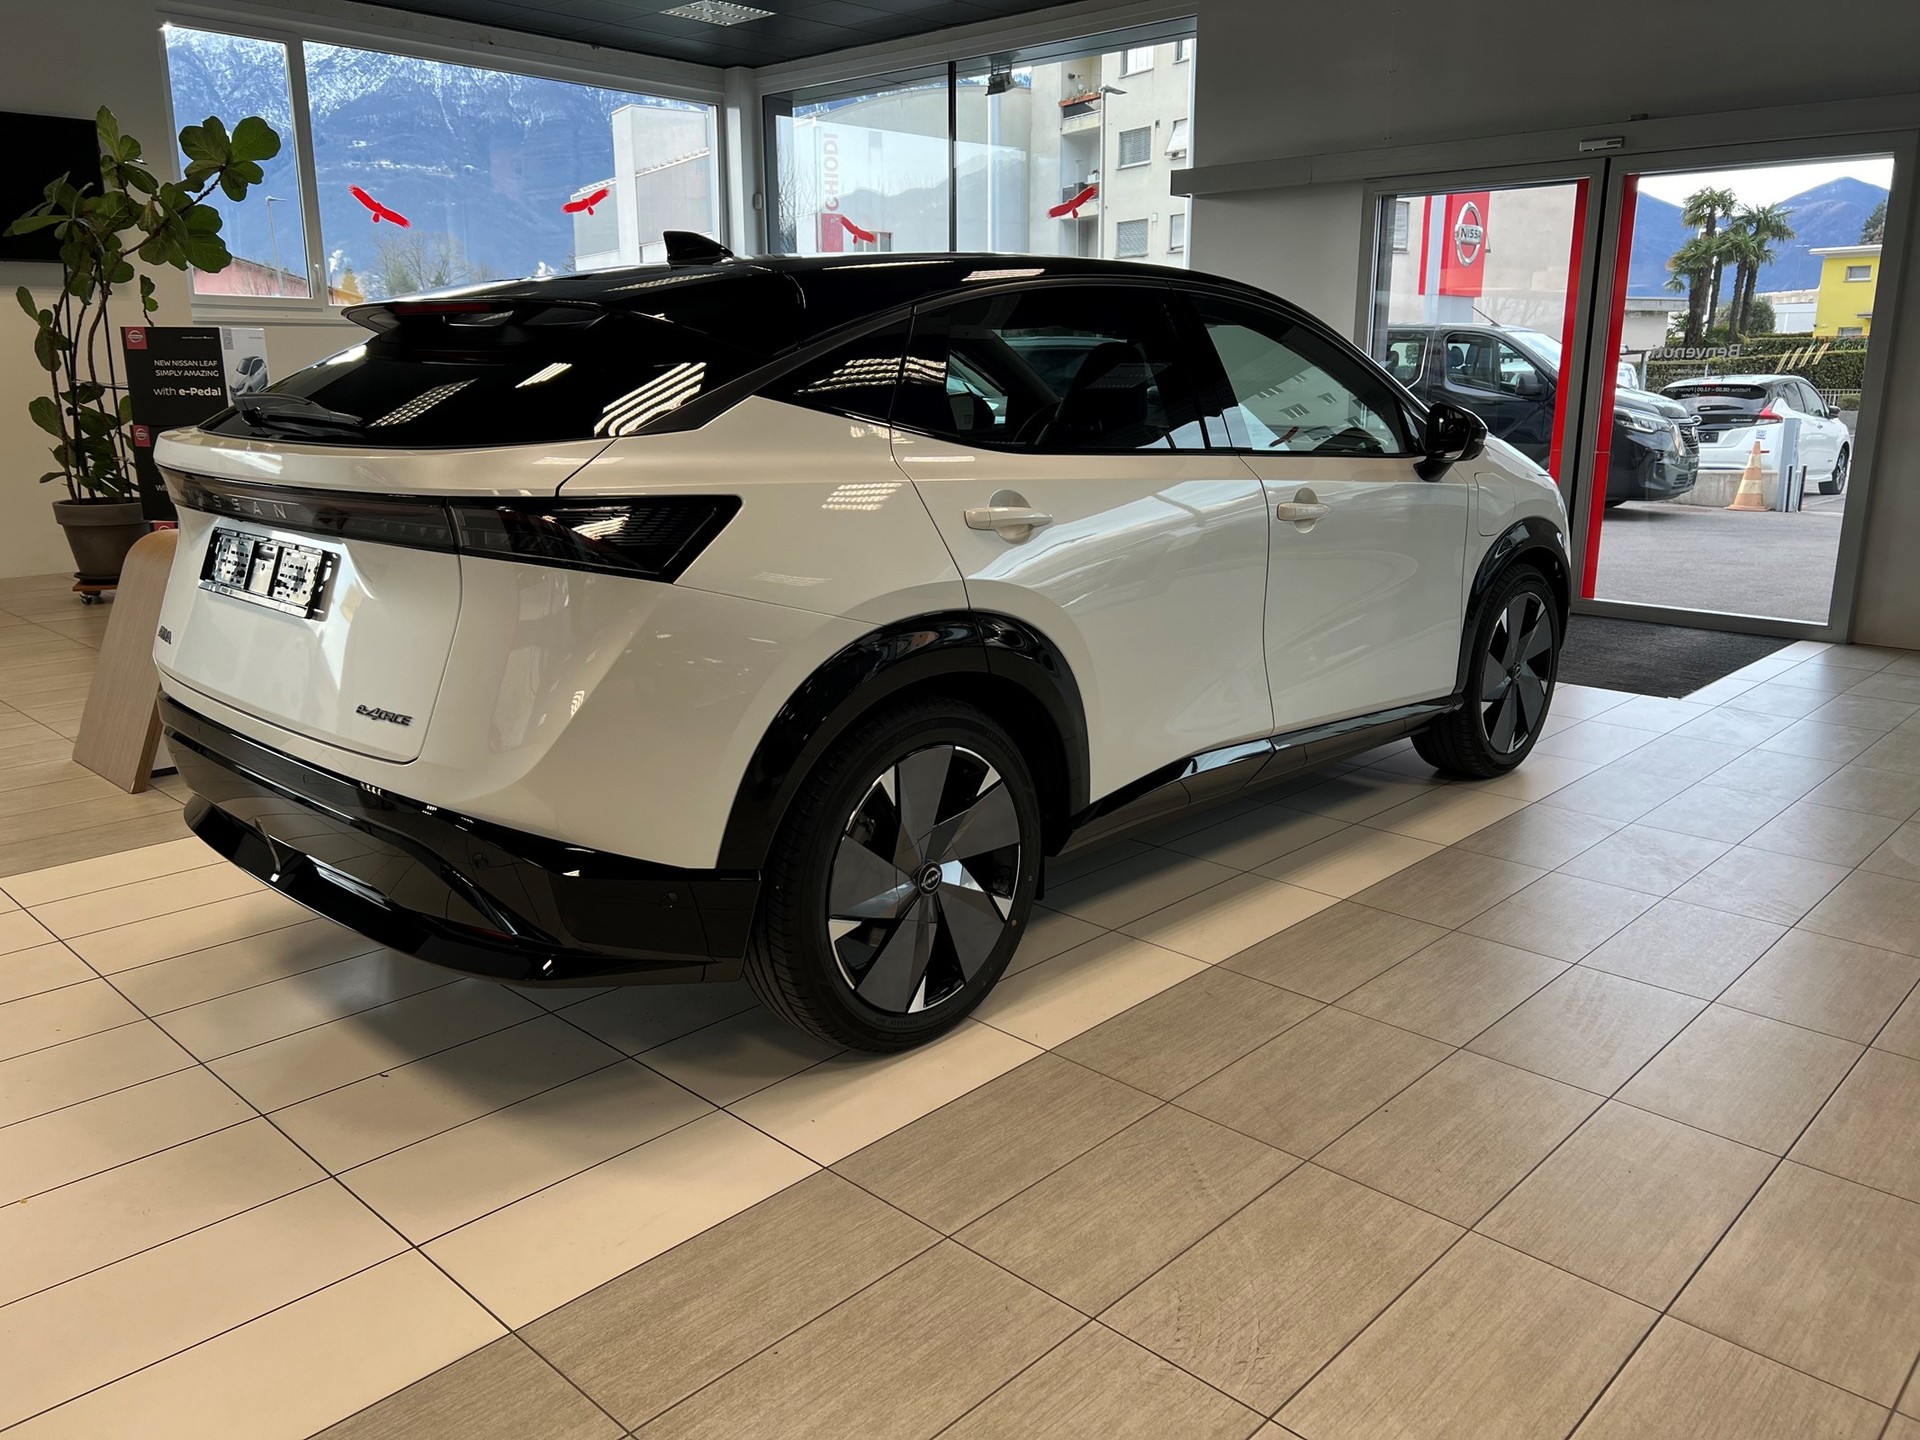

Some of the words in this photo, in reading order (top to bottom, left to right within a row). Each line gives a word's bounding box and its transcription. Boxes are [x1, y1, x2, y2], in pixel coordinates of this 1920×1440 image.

[823, 133, 839, 211] CHIODI
[153, 387, 177, 396] with
[178, 387, 222, 396] e-Pedal
